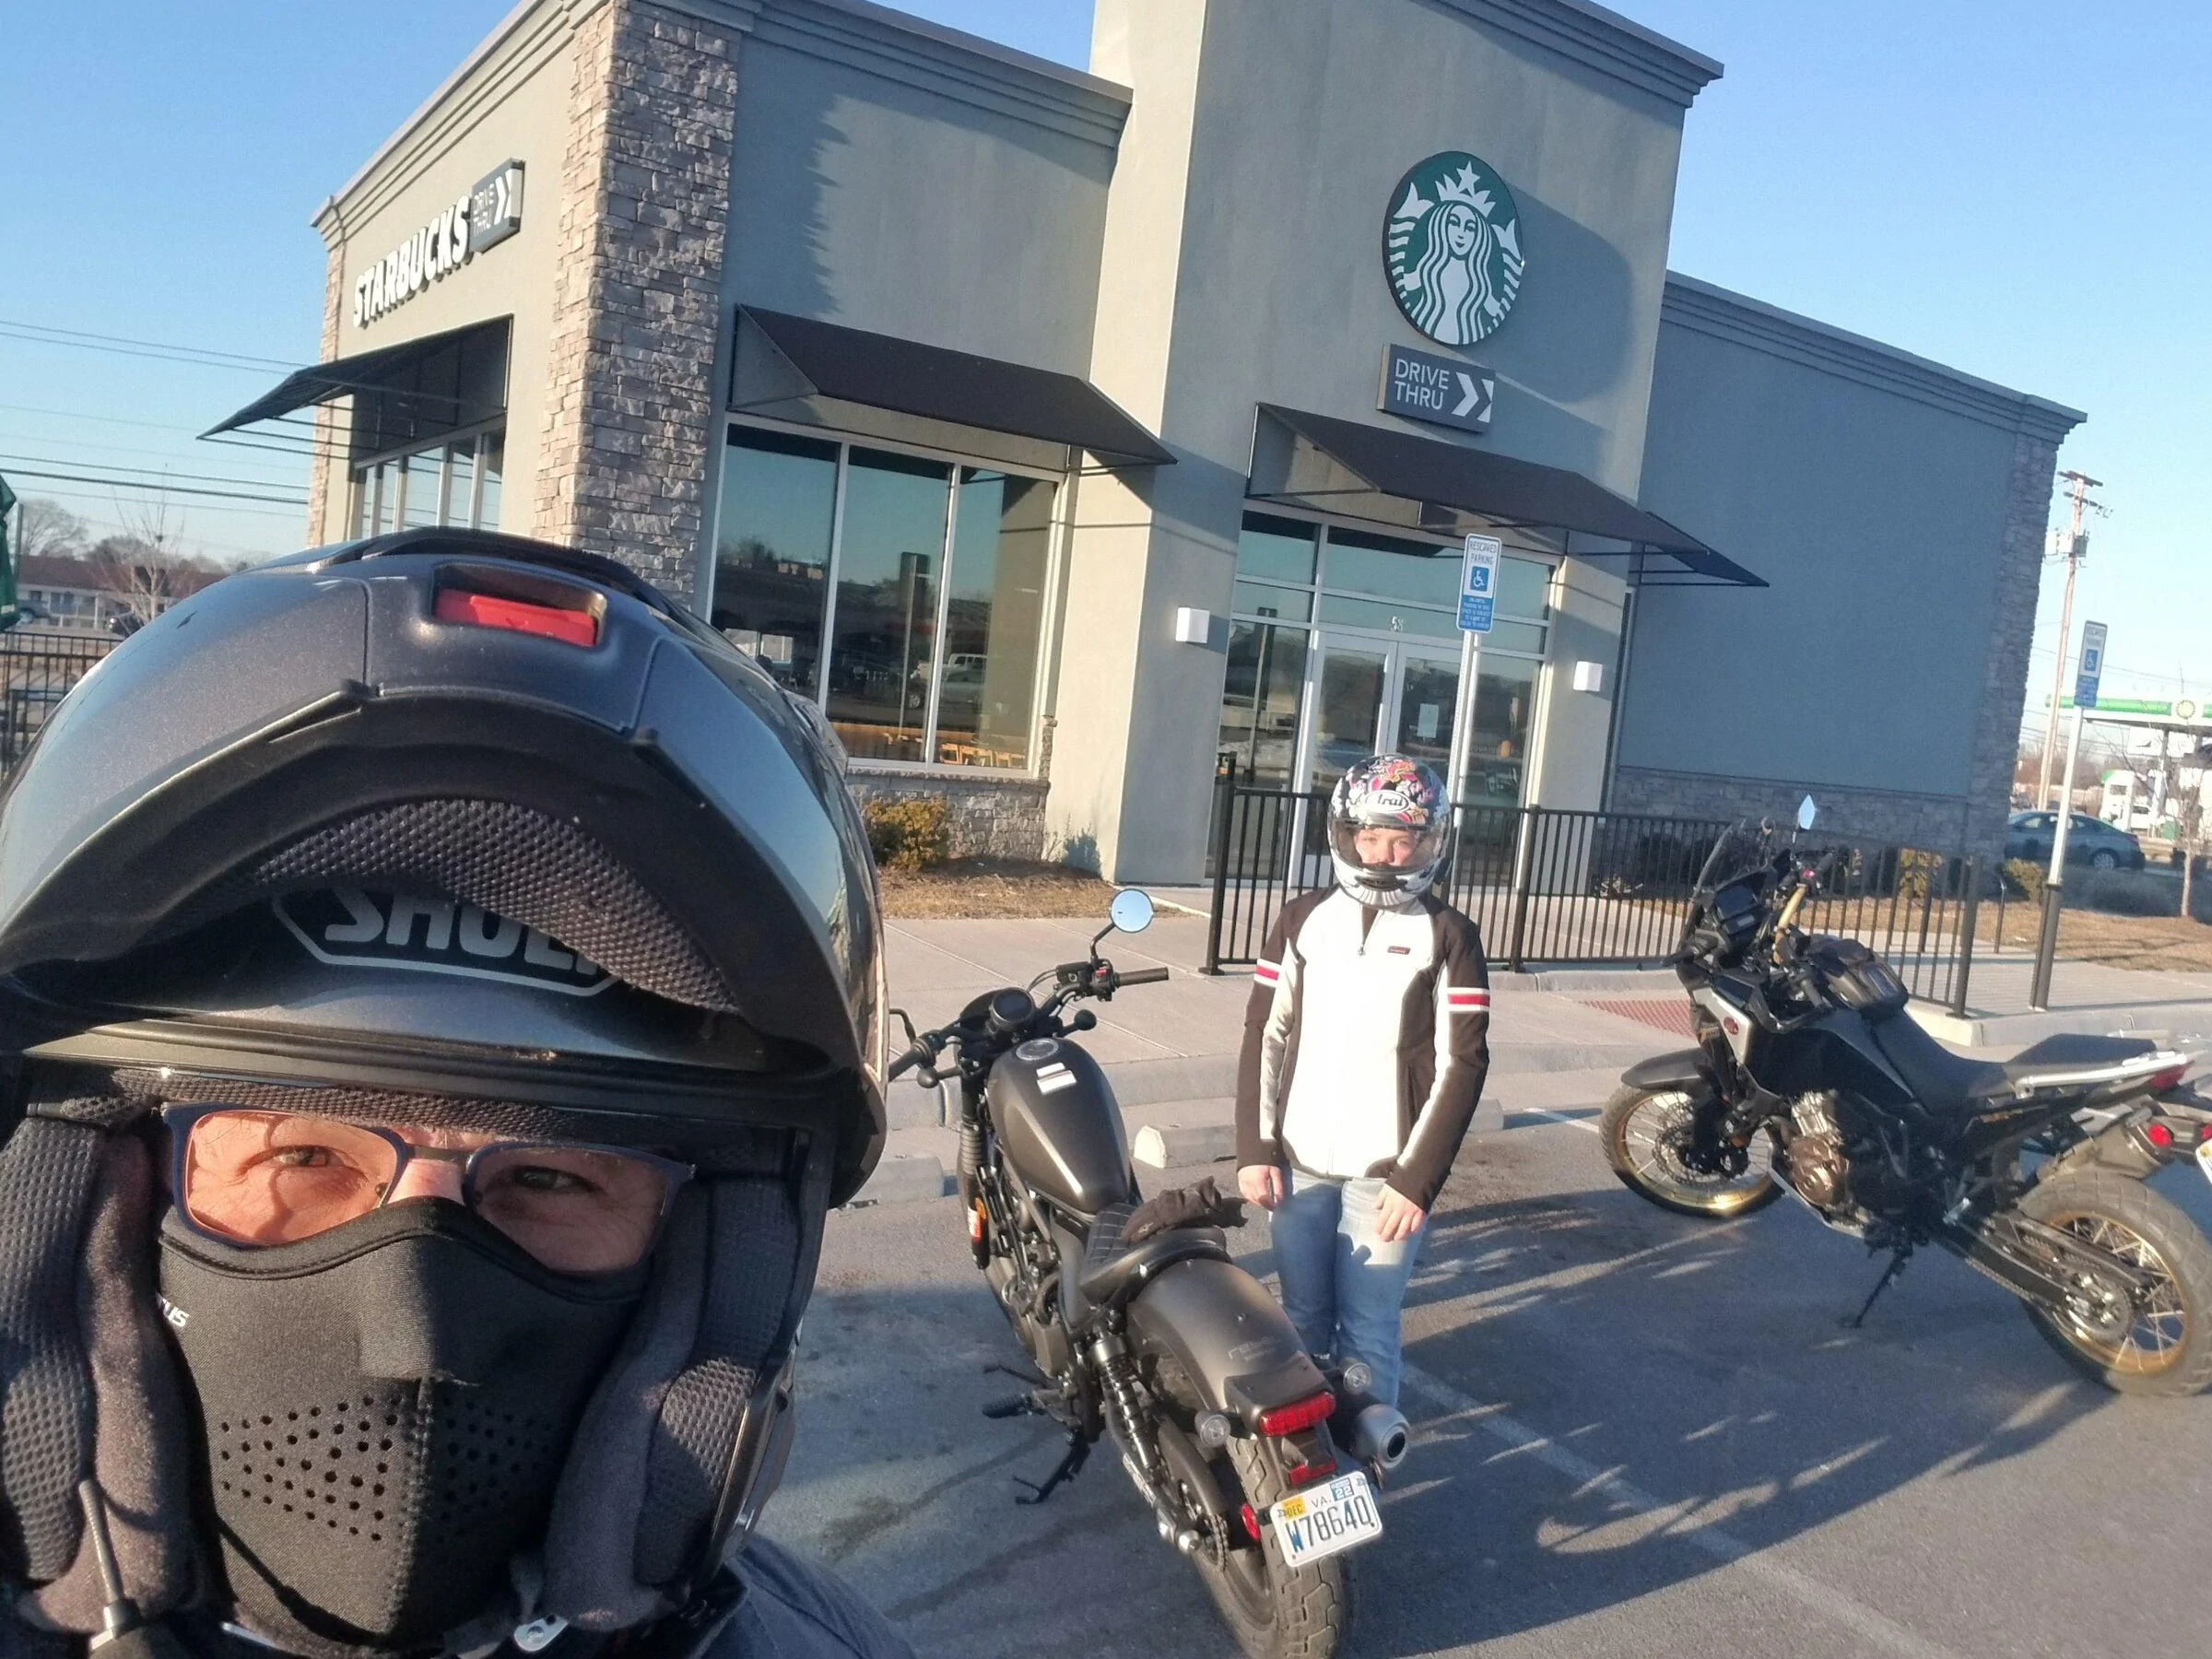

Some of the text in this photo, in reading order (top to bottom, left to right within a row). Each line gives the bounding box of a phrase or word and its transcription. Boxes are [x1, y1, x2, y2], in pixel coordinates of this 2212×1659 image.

[353, 194, 470, 328] STARBUCKS
[1394, 358, 1450, 390] DRIVE
[1394, 380, 1444, 410] THRU
[1469, 540, 1498, 554] RESERVED
[1470, 553, 1494, 565] PARKING
[1377, 794, 1403, 806] rai
[324, 888, 602, 977] SHO
[1334, 1486, 1353, 1501] 22
[1285, 1495, 1372, 1554] W78640
